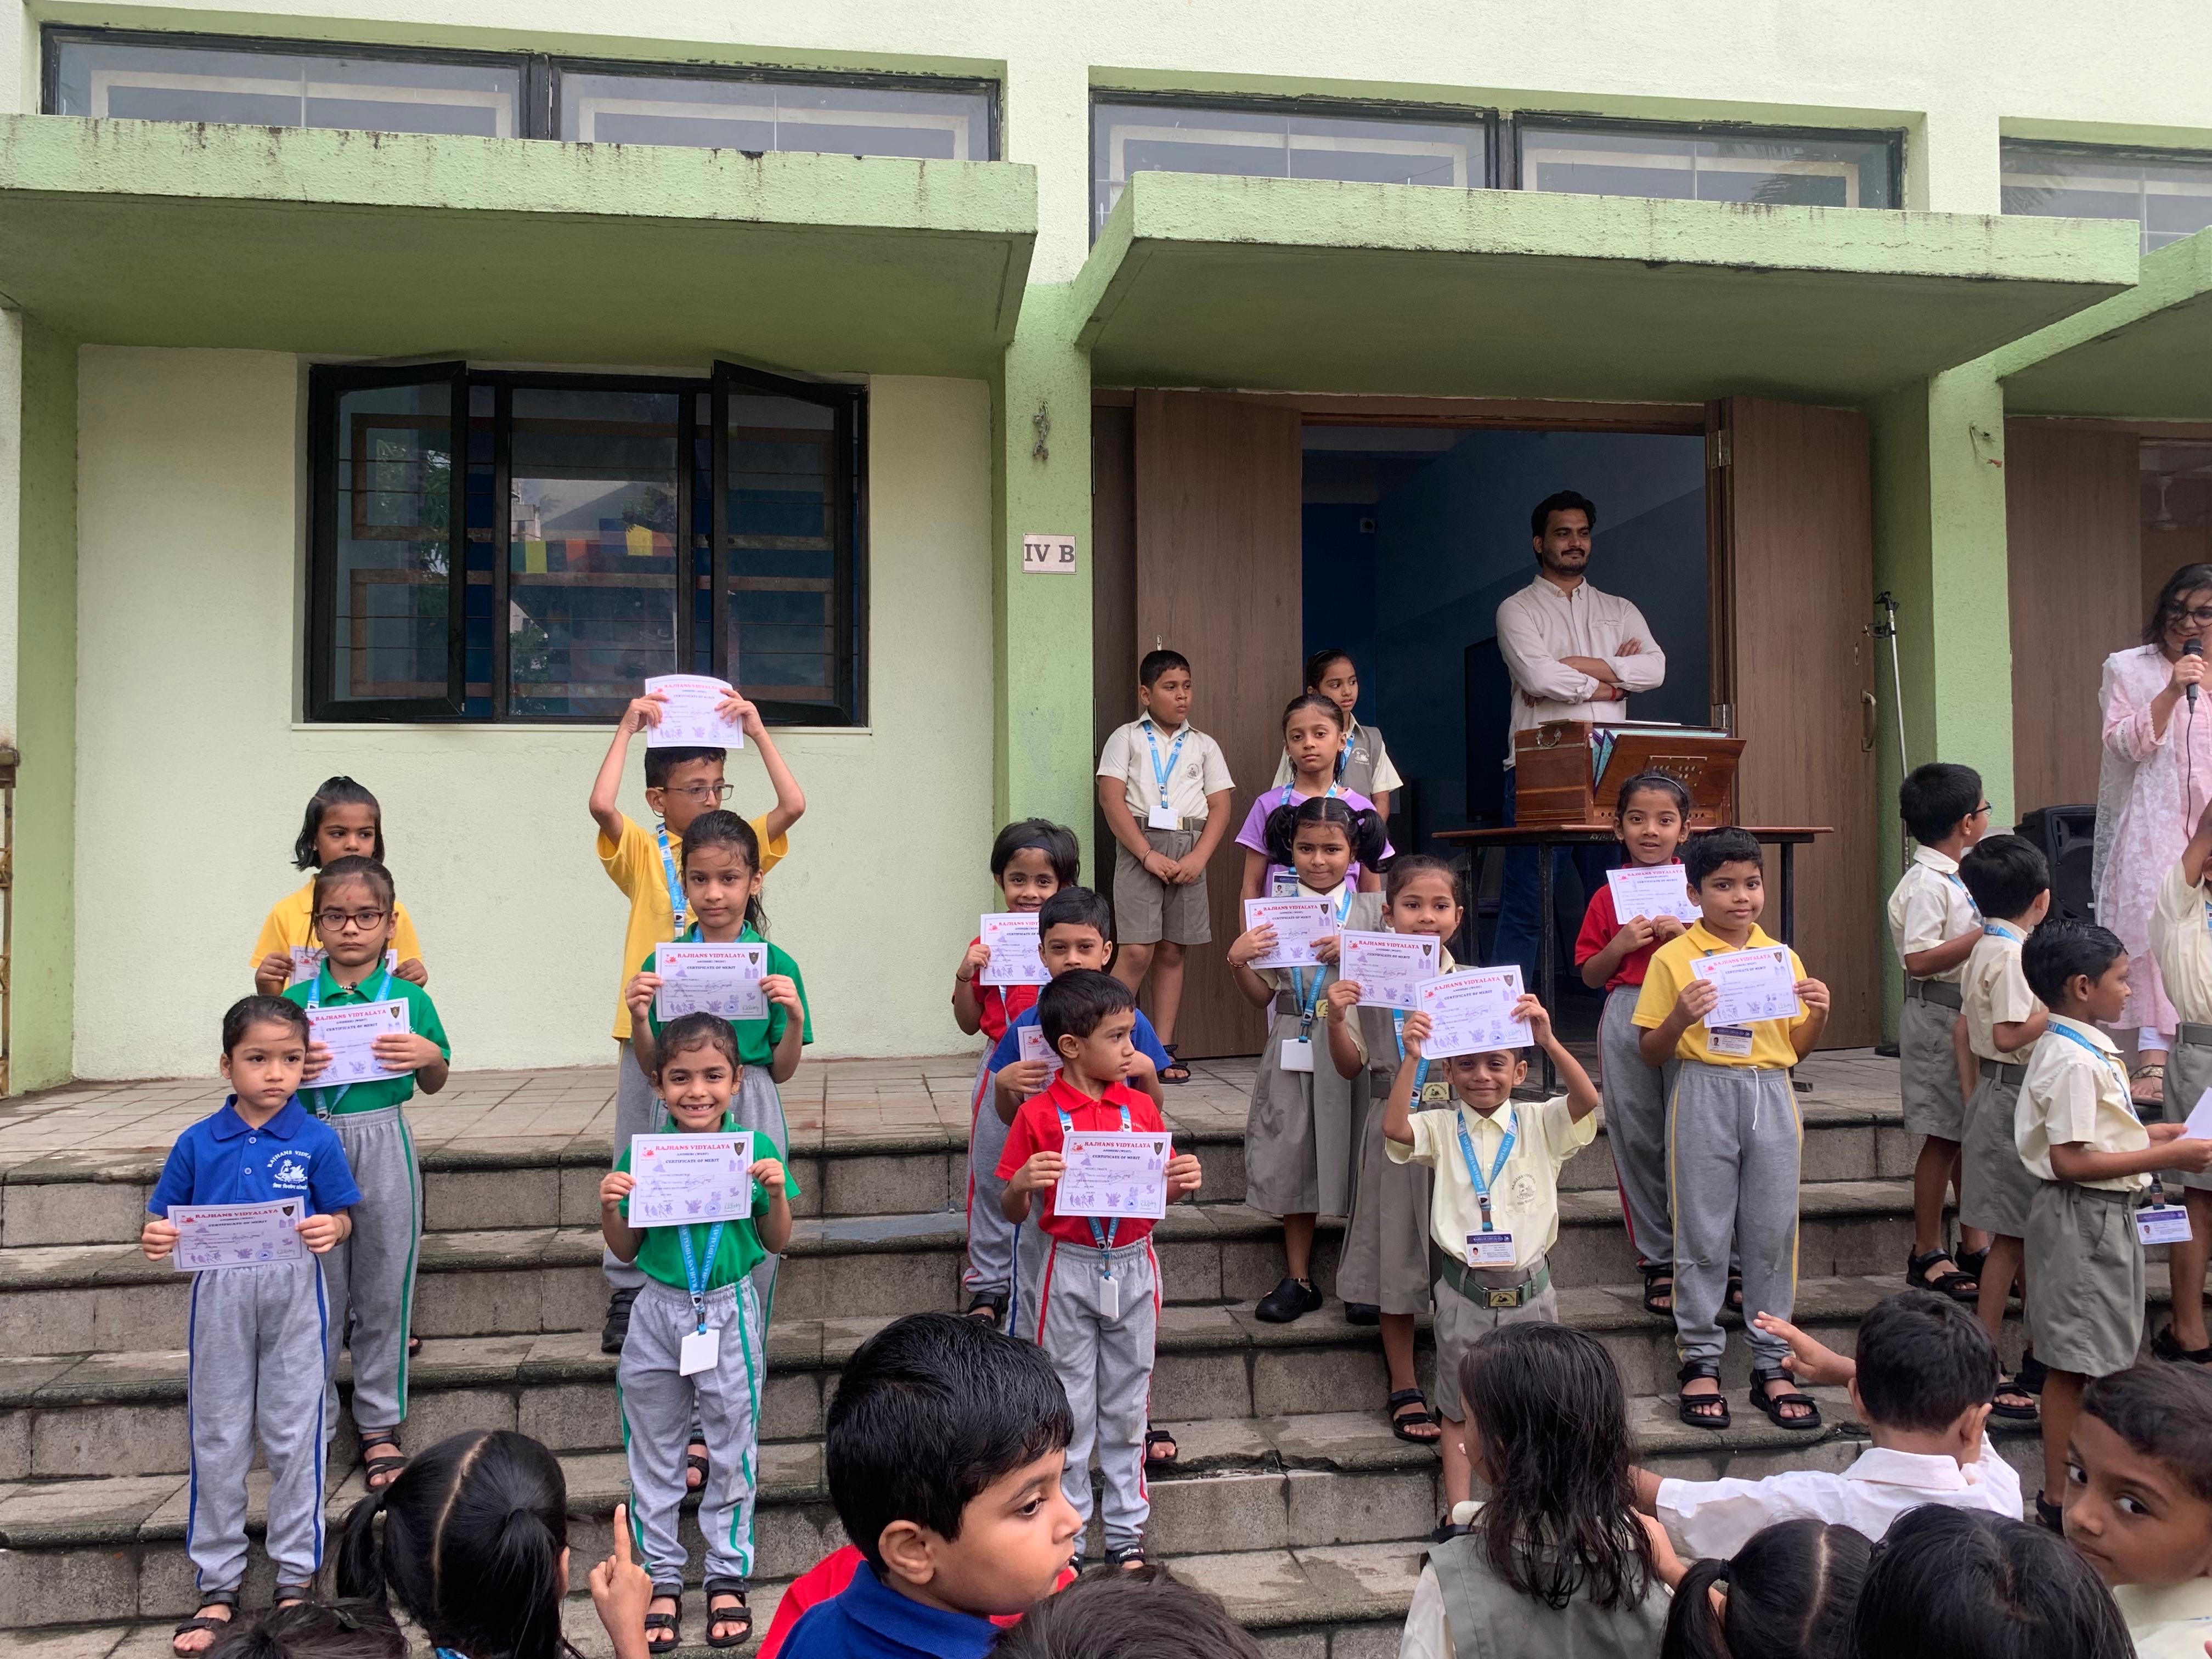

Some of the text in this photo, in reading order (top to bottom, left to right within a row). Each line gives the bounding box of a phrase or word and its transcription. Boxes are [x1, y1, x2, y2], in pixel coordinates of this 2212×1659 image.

[1025, 544, 1075, 563] IV B
[1434, 977, 1500, 991] RAJHANS VIDYALAYA
[267, 1150, 311, 1167] RAJHANS VIDYA
[689, 1260, 698, 1288] RAJHANS
